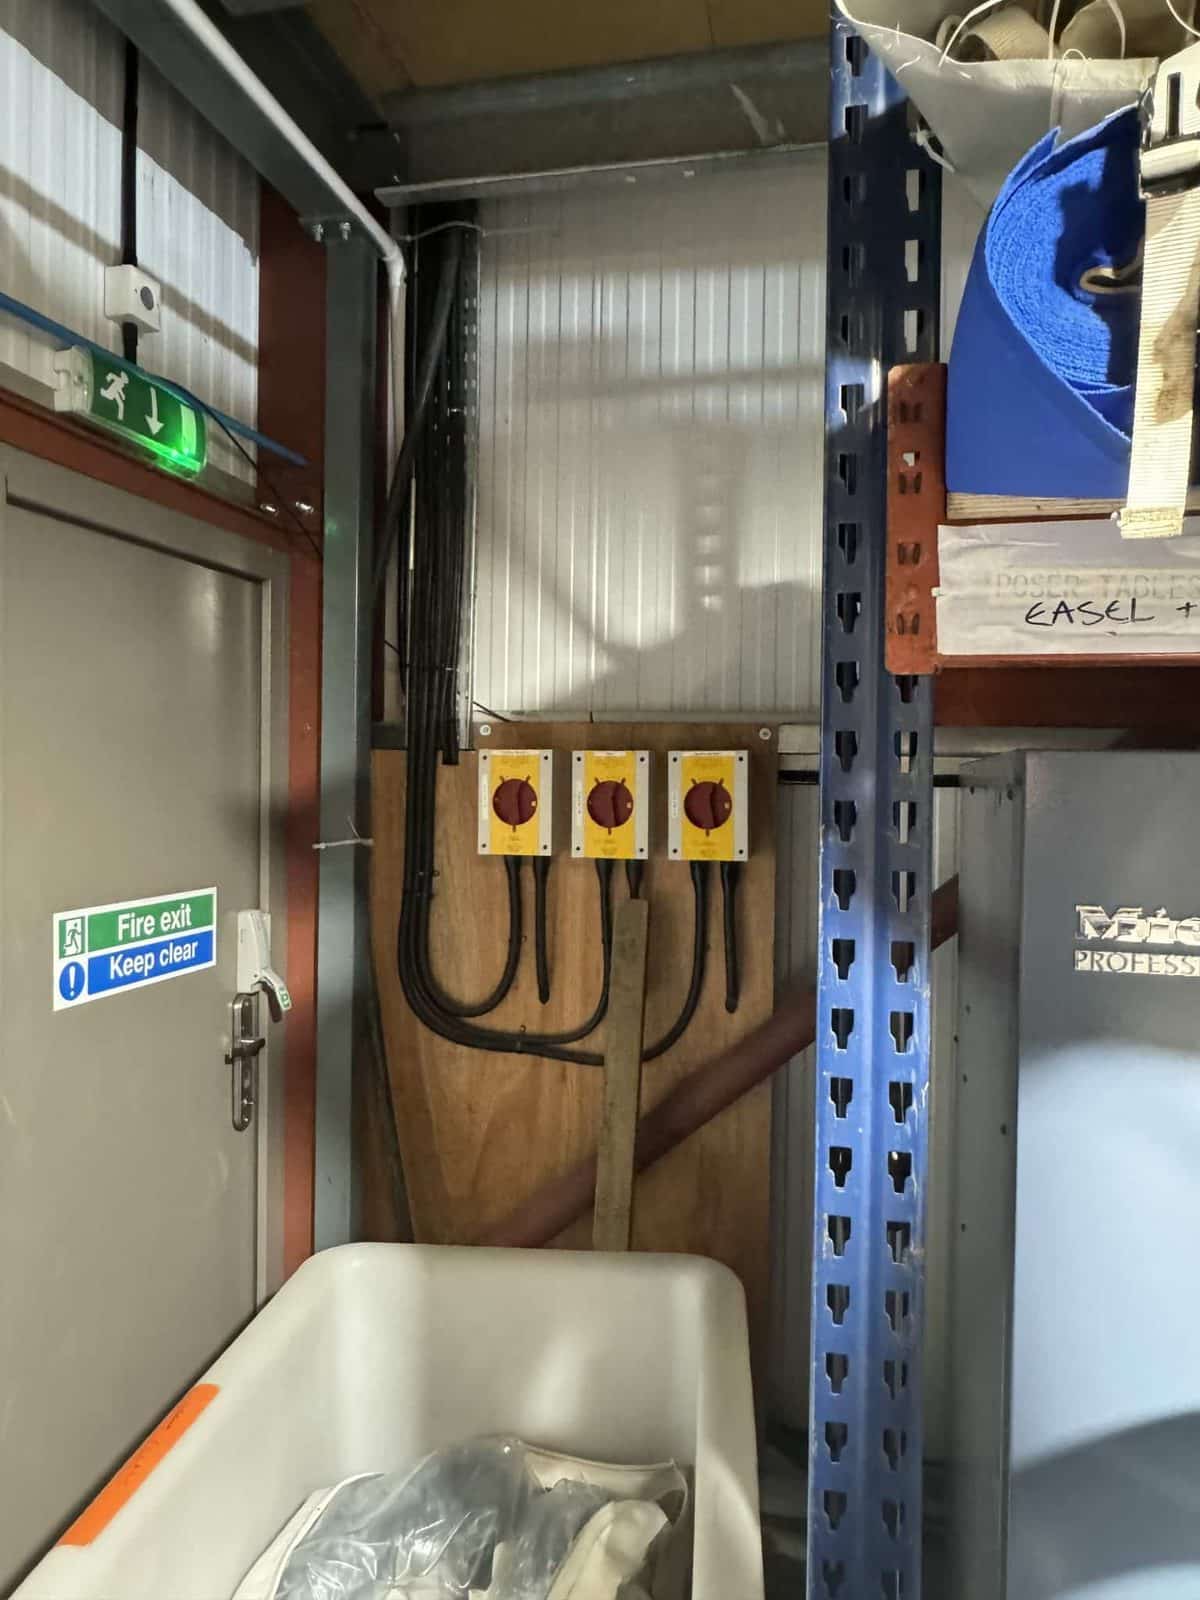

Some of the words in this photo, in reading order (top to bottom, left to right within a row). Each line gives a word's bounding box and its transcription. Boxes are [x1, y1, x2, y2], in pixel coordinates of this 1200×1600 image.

[1025, 597, 1155, 626] EASEL
[118, 912, 155, 941] Fire
[160, 903, 192, 931] exit
[109, 953, 155, 980] Keep
[159, 941, 198, 966] clear
[1074, 950, 1200, 977] PROFESS
